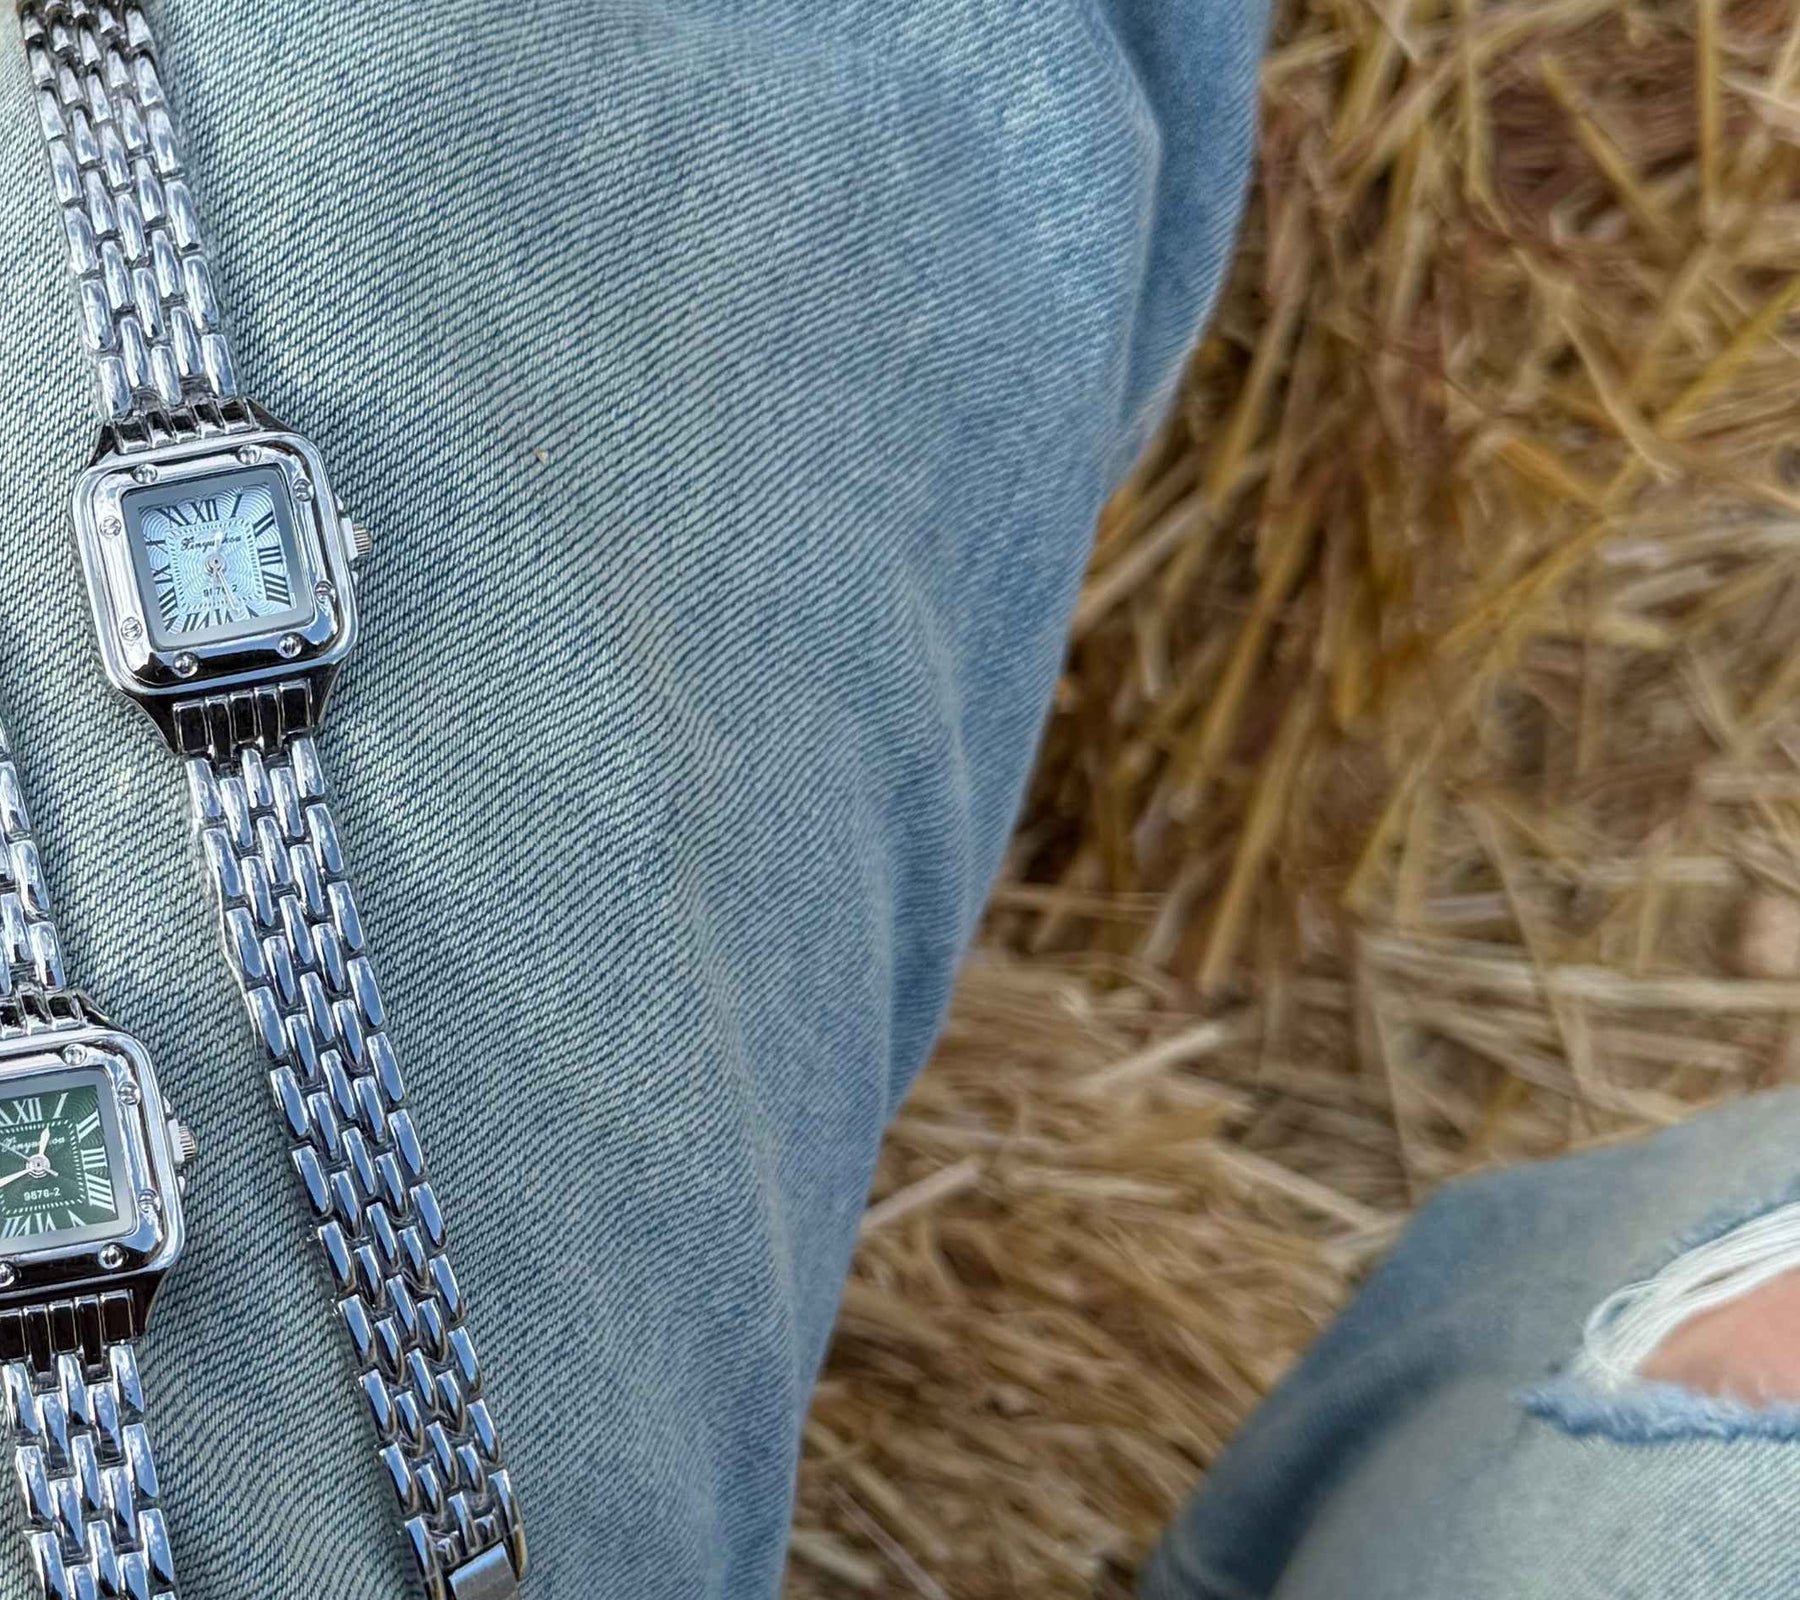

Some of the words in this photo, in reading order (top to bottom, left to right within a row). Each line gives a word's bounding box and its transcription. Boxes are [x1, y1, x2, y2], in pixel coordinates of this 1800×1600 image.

[155, 505, 191, 528] XI
[190, 499, 219, 525] XII
[253, 510, 275, 538] II
[258, 545, 283, 566] III
[12, 1097, 42, 1124] XII
[76, 1108, 100, 1143] II
[81, 1146, 108, 1170] III
